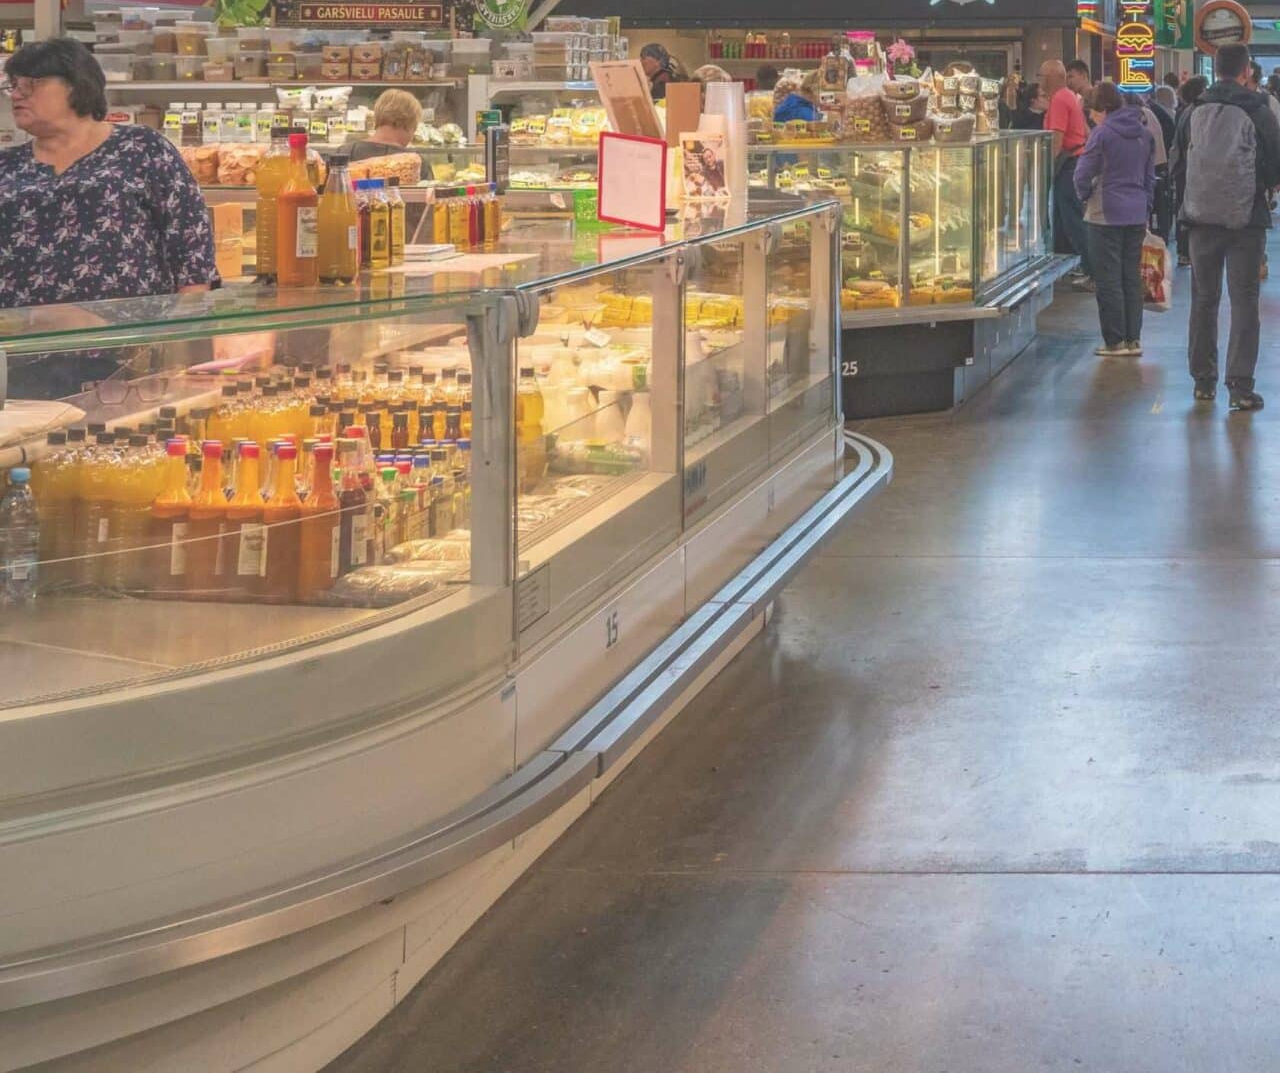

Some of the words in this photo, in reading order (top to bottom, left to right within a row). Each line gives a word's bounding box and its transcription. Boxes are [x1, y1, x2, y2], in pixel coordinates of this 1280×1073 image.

[317, 5, 375, 19] GARŠVIELU
[378, 7, 424, 19] PASAULE
[841, 360, 859, 376] 25
